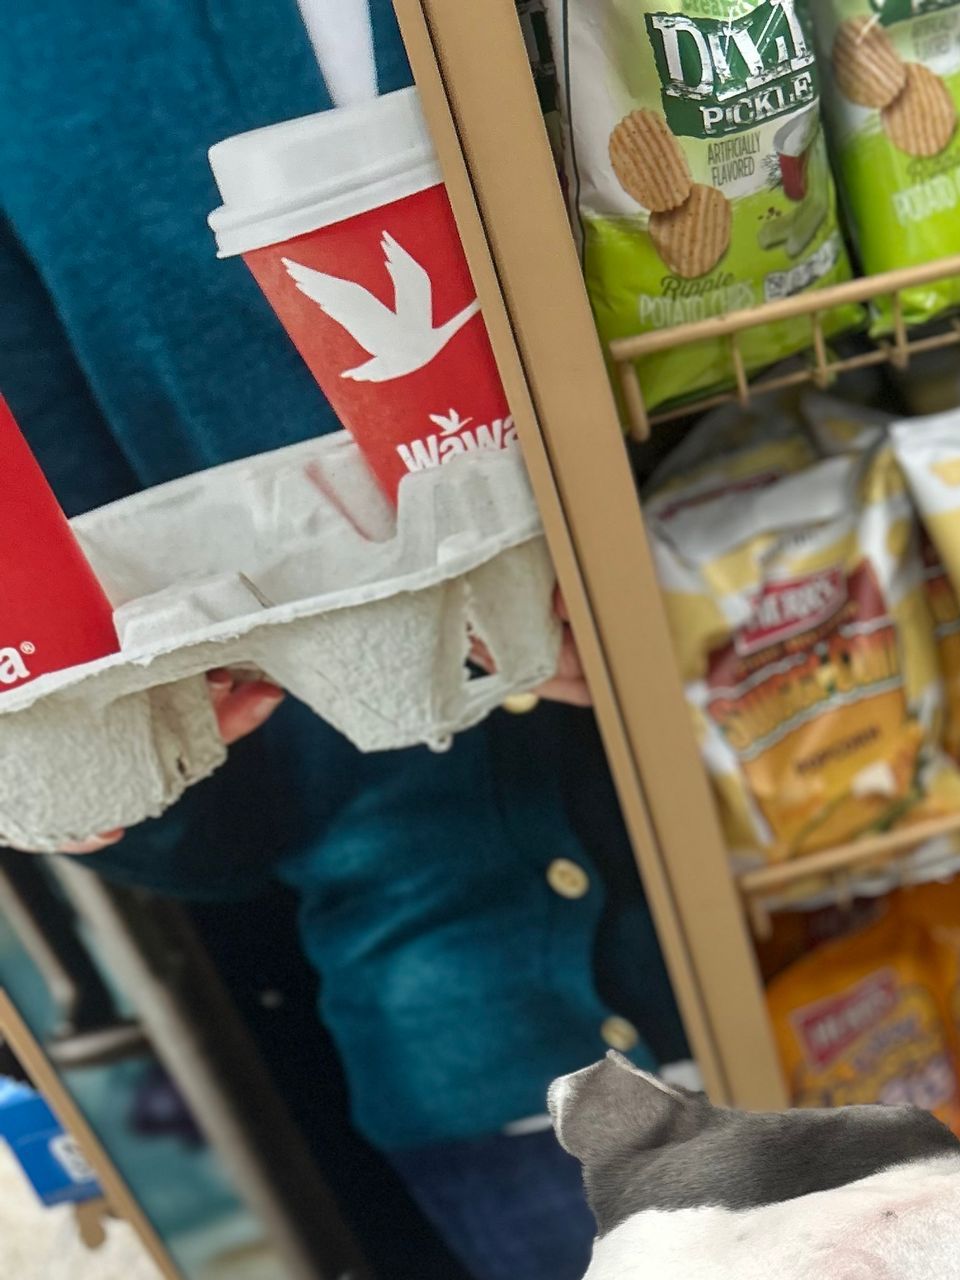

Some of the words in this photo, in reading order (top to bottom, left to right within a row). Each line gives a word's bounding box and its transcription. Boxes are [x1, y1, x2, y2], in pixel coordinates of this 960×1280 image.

[700, 71, 814, 135] PICKLE
[707, 132, 761, 166] ARTIFICIALLY
[711, 156, 756, 186] FLAVORED
[660, 271, 735, 303] Ripple
